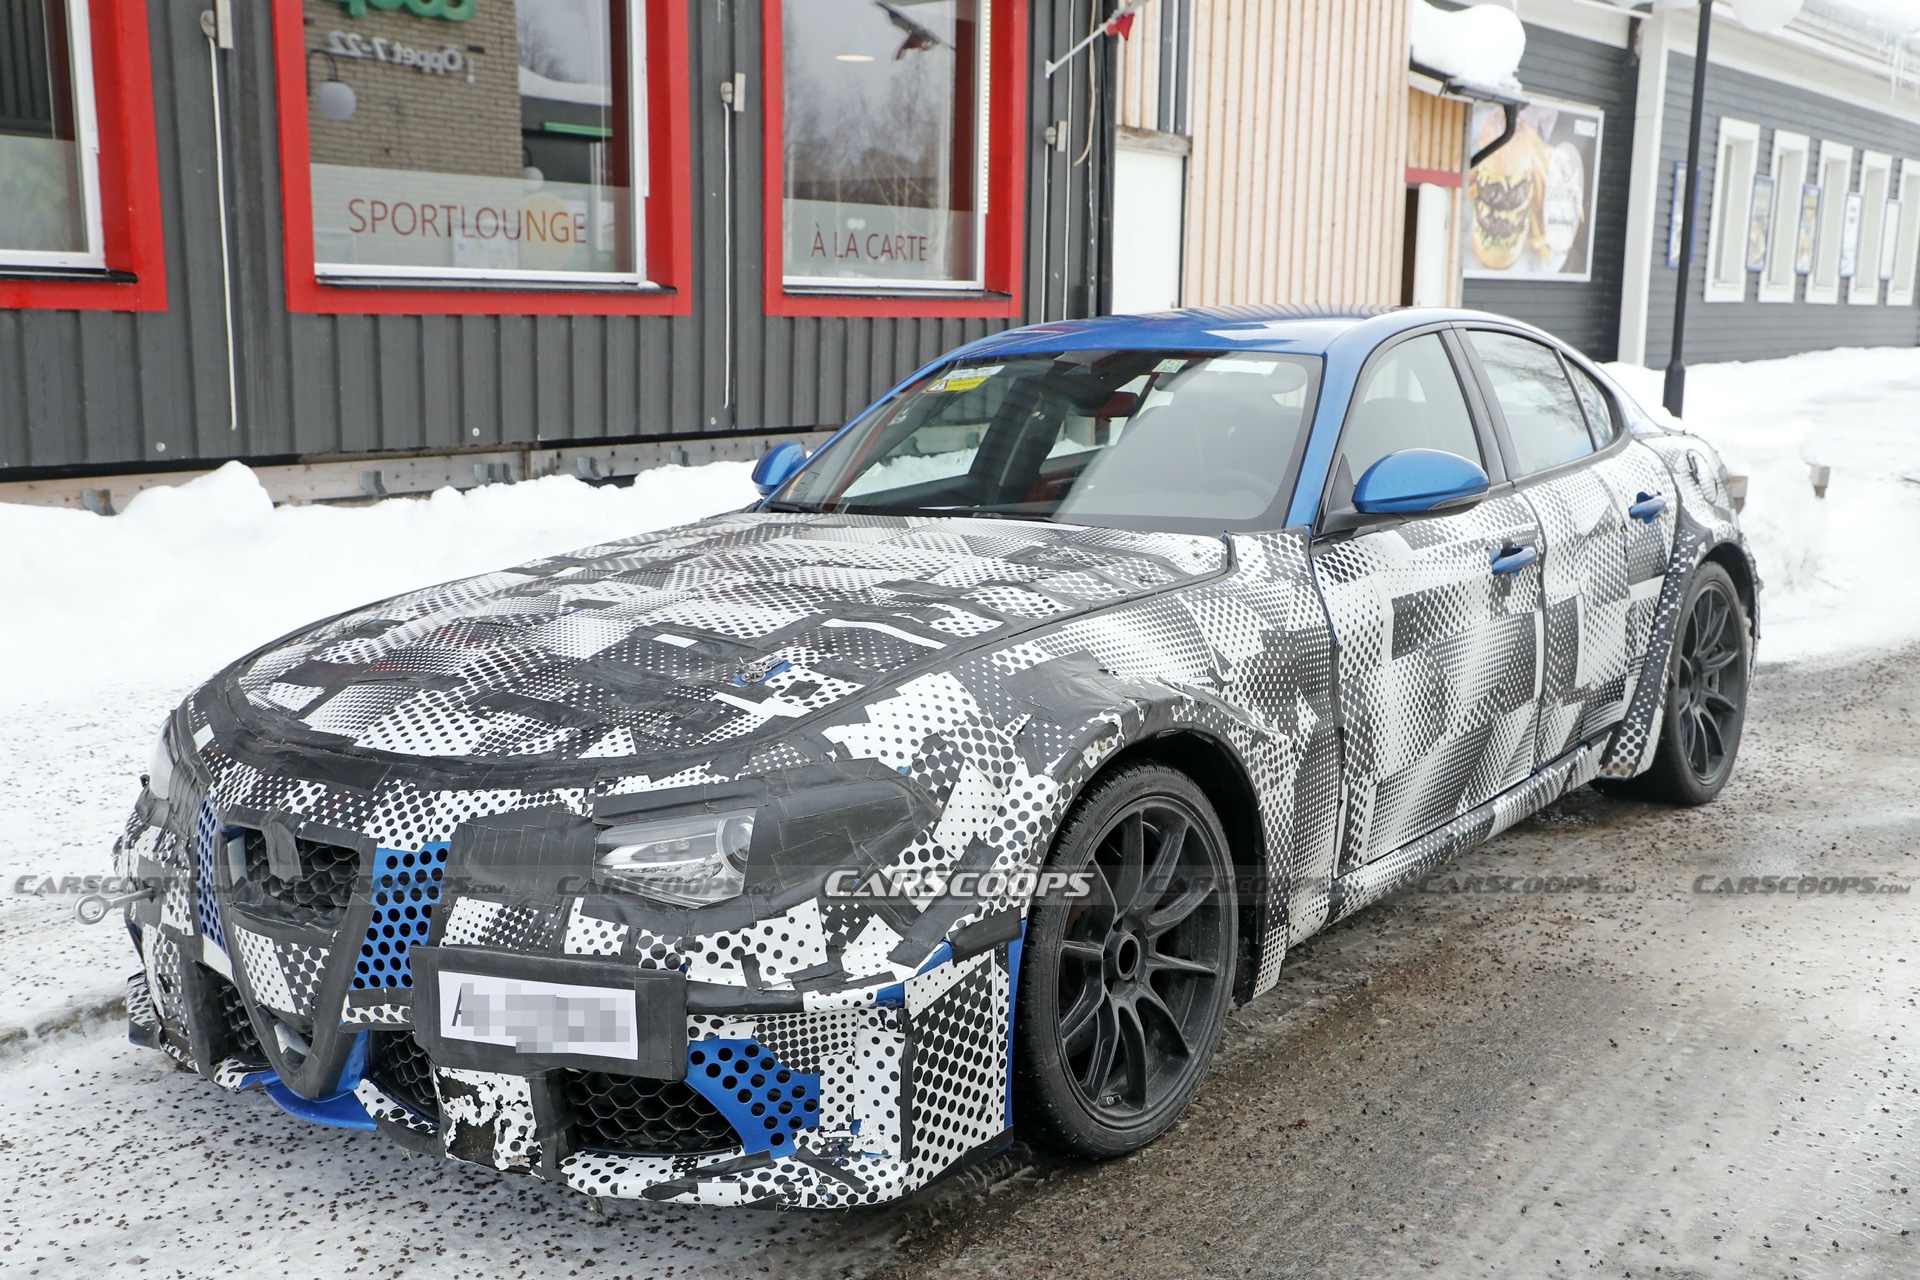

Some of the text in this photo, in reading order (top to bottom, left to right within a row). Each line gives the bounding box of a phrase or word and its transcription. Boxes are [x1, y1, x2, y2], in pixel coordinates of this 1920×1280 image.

[348, 198, 587, 244] SPORTLOUNGE
[811, 222, 928, 261] À LA CARTE
